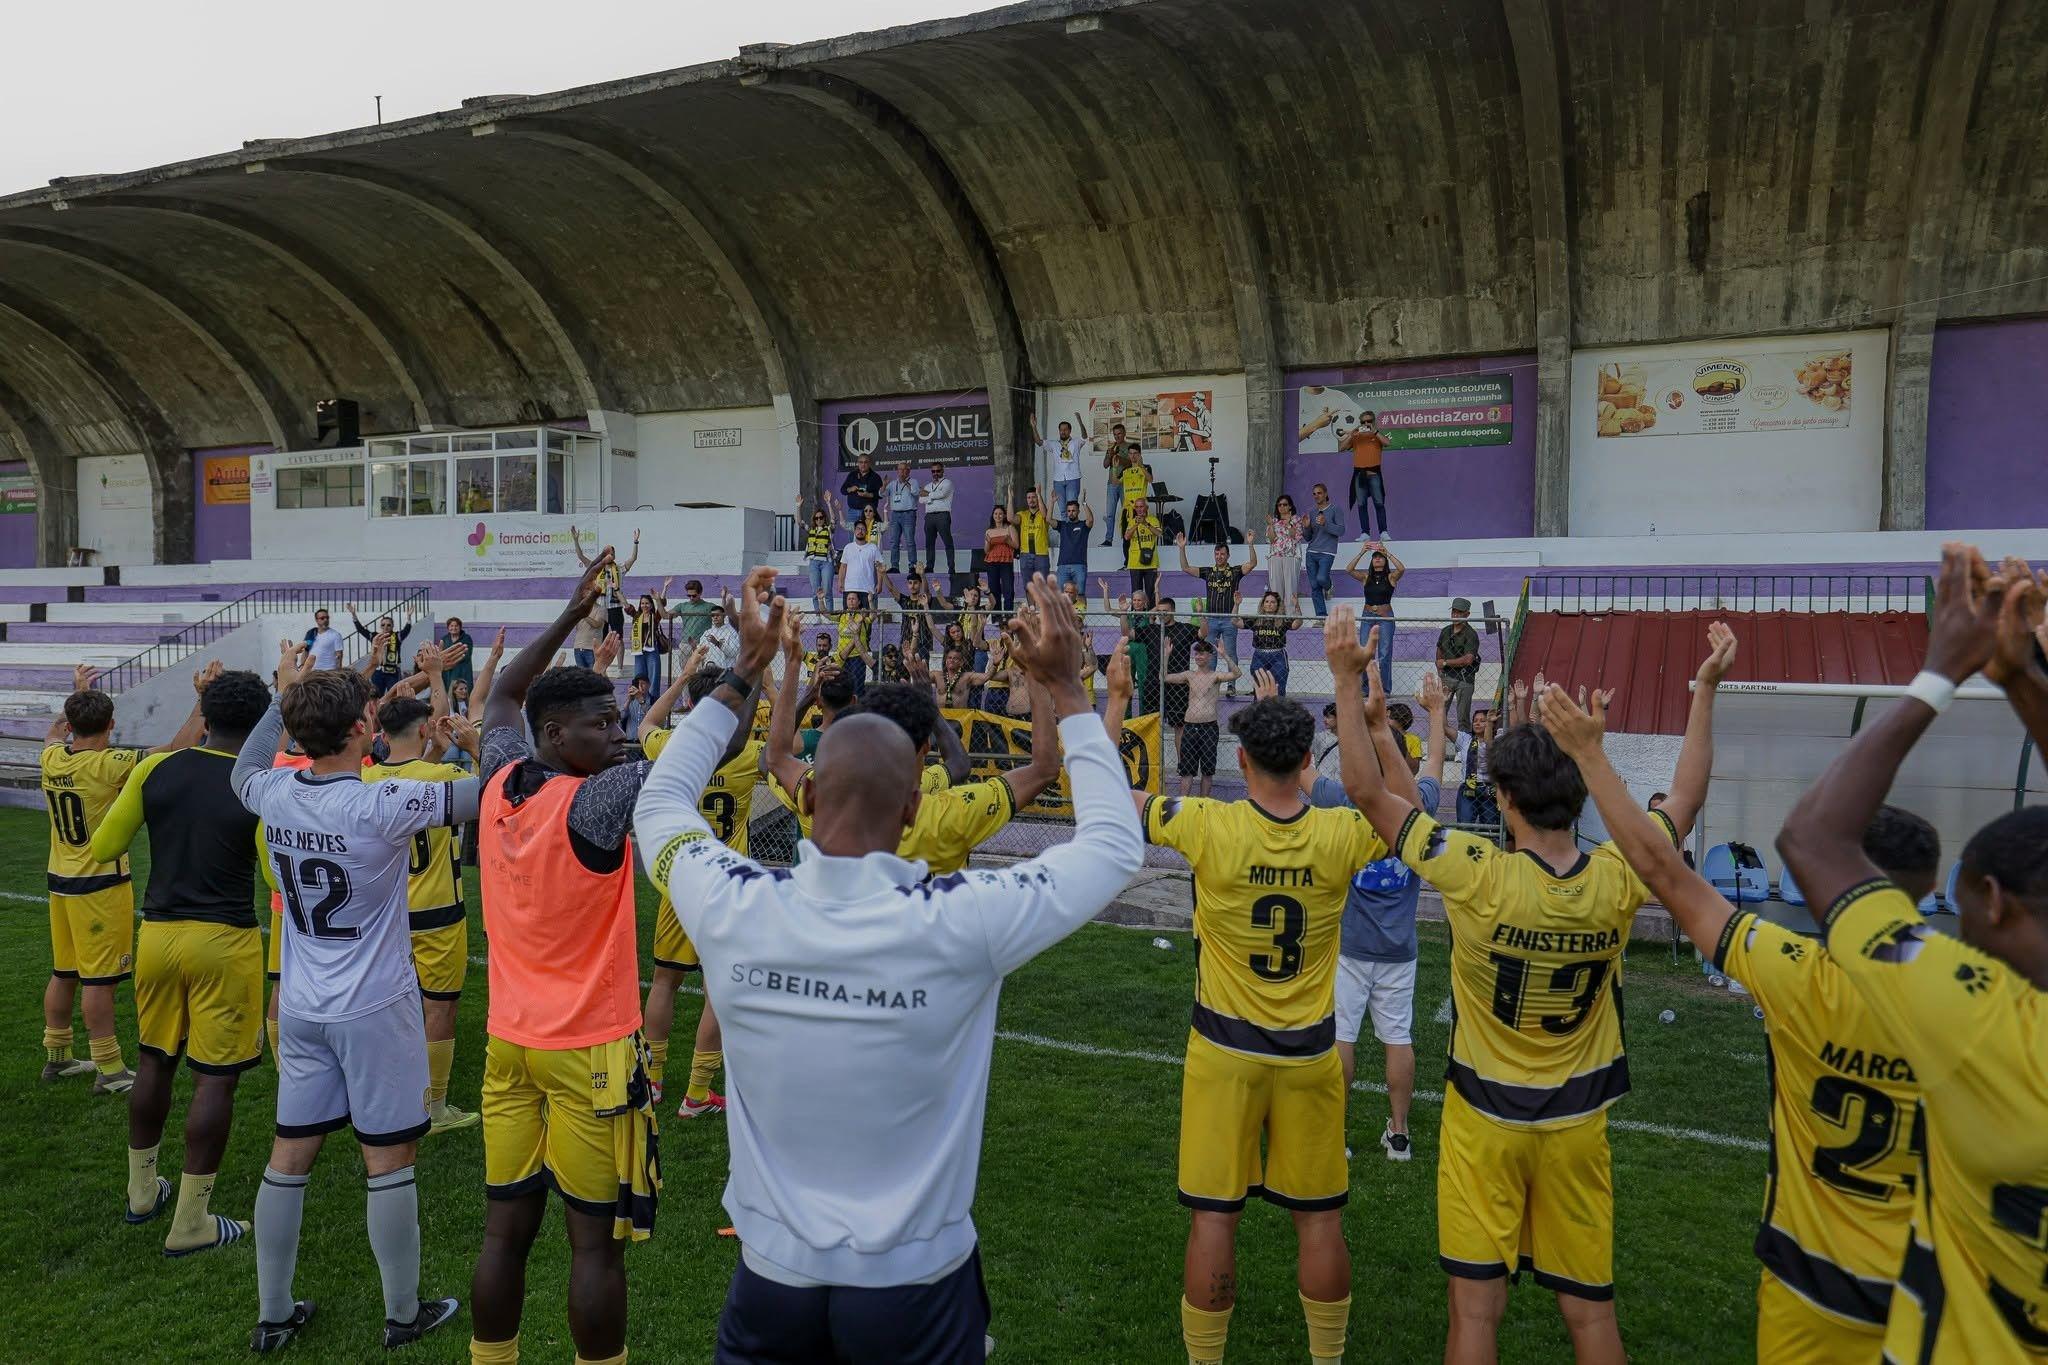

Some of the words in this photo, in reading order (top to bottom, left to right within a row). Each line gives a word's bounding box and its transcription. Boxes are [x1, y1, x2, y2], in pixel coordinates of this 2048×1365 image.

[1697, 364, 1742, 375] VIMENTA
[1365, 390, 1392, 398] CLUBE
[1393, 387, 1447, 396] DESPORTIVO
[1461, 384, 1501, 392] GOUVEIA
[1457, 393, 1502, 404] campanha
[1381, 411, 1484, 425] #ViolênciaZero
[699, 431, 737, 440] CAMAROTE-2
[886, 414, 989, 443] LEONEL
[1408, 431, 1425, 440] pela
[1427, 429, 1448, 438] ética
[1460, 427, 1502, 437] desporto.
[886, 443, 924, 452] MATERIAIS
[926, 442, 931, 450] &
[934, 440, 989, 449] TRANSPORTES
[214, 466, 249, 480] Auto
[47, 790, 90, 847] 10
[266, 825, 292, 847] DAS
[296, 831, 347, 853] NEVES
[1249, 865, 1313, 887] MOTTA
[273, 851, 362, 941] 12
[1249, 894, 1308, 984] 3
[1492, 923, 1620, 953] FINISTERRA
[1488, 950, 1611, 1038] 13
